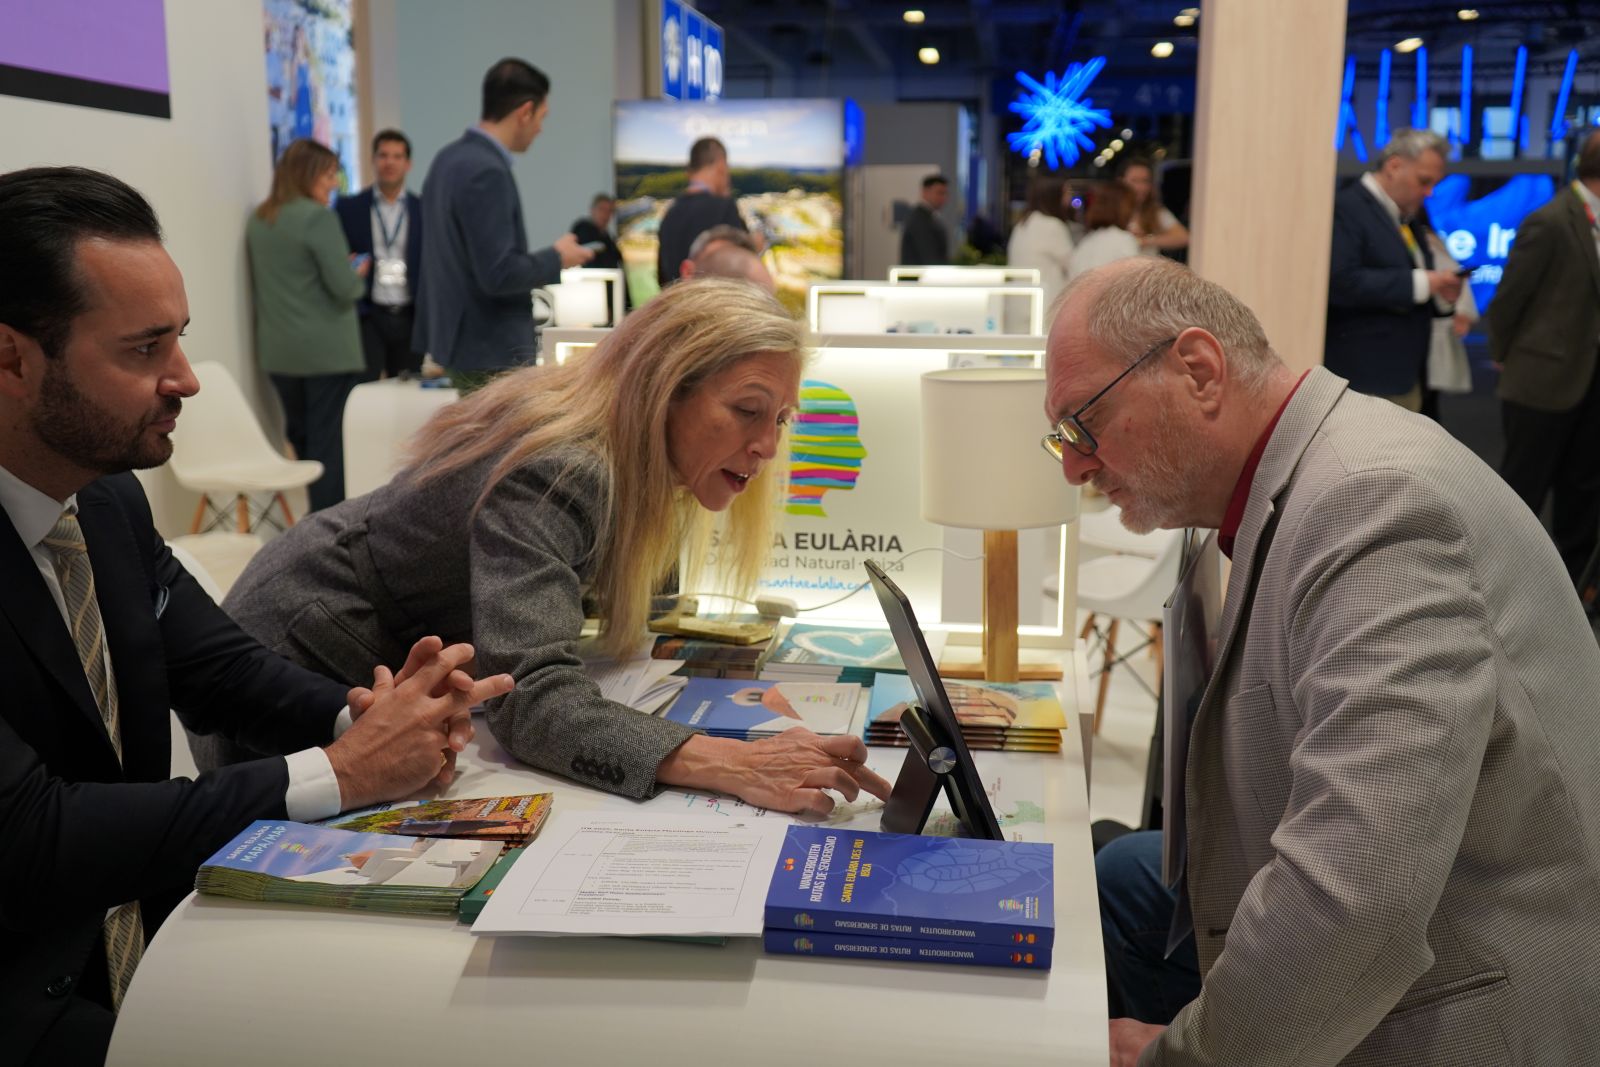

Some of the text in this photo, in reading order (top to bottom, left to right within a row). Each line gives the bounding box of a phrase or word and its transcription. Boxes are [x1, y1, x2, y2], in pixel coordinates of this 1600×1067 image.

[794, 529, 903, 553] EULÀRIA
[795, 555, 855, 570] Natural
[798, 843, 822, 889] WANDERROUTEN
[810, 836, 837, 902] RUTAS DE SENDERISMO
[841, 883, 855, 903] SANTA
[834, 920, 976, 938] WANDERROUTEN RUTAS DE SENDERISMO
[834, 943, 975, 958] WANDERROUTEN RUTAS DE SENDERISMO
